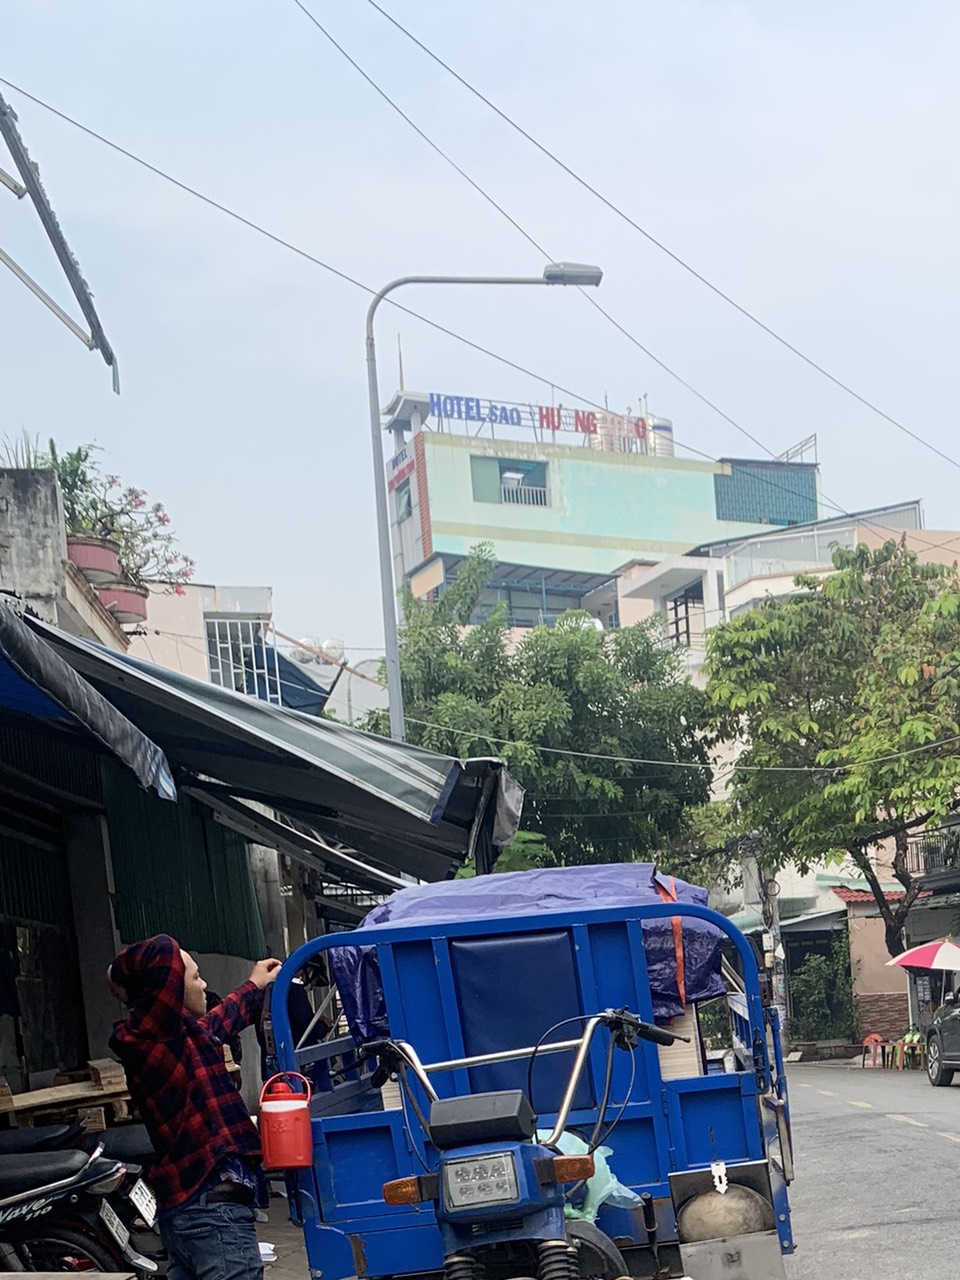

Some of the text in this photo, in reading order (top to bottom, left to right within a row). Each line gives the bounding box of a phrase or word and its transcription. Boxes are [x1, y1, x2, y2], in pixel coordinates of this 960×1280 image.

[429, 392, 485, 422] HOTEL
[488, 404, 522, 427] SAO
[24, 1205, 53, 1222] 110
